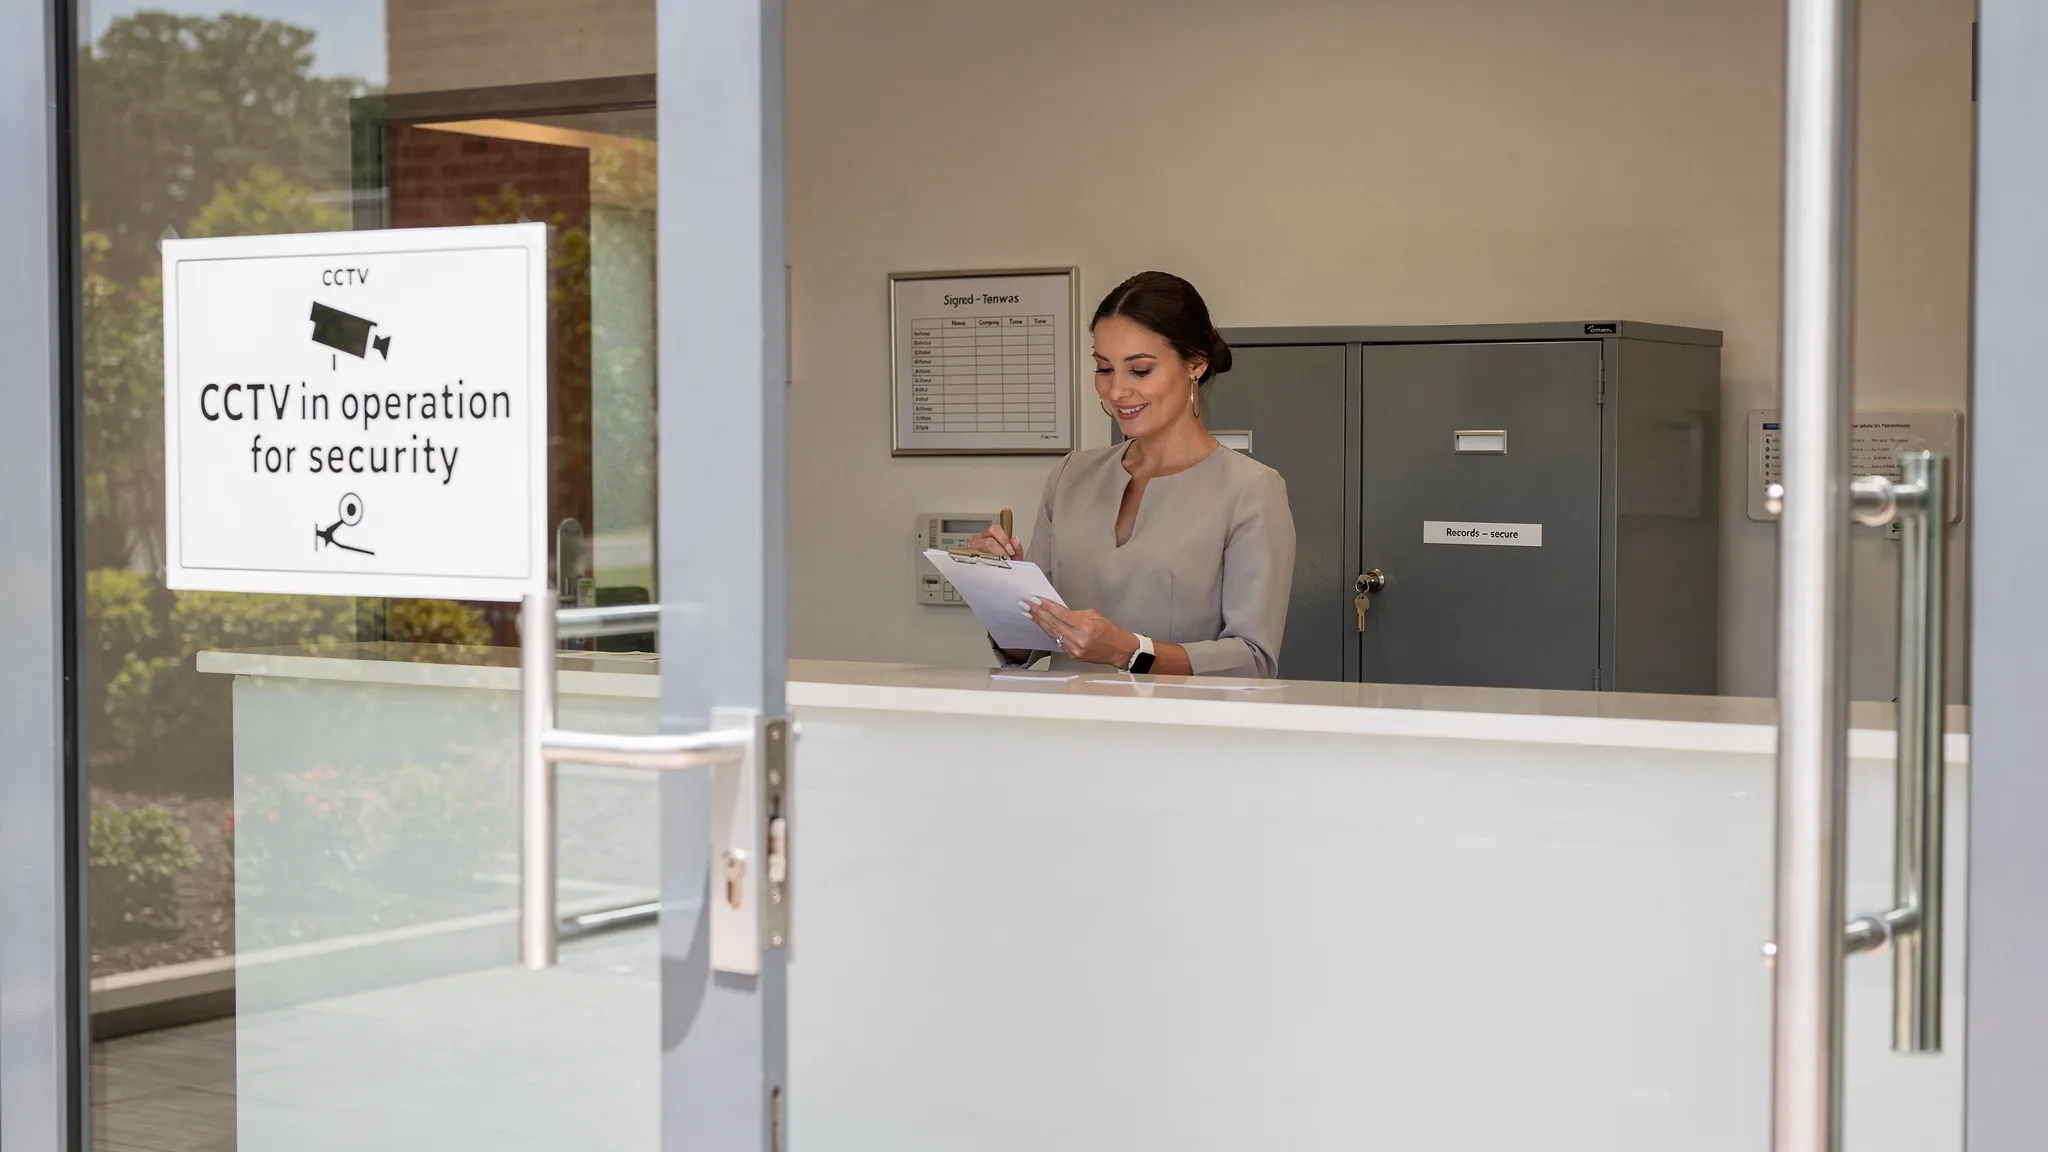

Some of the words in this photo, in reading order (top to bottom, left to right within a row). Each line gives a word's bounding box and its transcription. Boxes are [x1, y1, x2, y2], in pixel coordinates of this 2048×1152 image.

[322, 268, 369, 286] CCTV
[200, 382, 291, 422] CCTV
[301, 381, 329, 420] in
[341, 379, 510, 431] operation
[251, 433, 296, 474] for
[309, 433, 459, 486] security
[1446, 527, 1479, 538] Records
